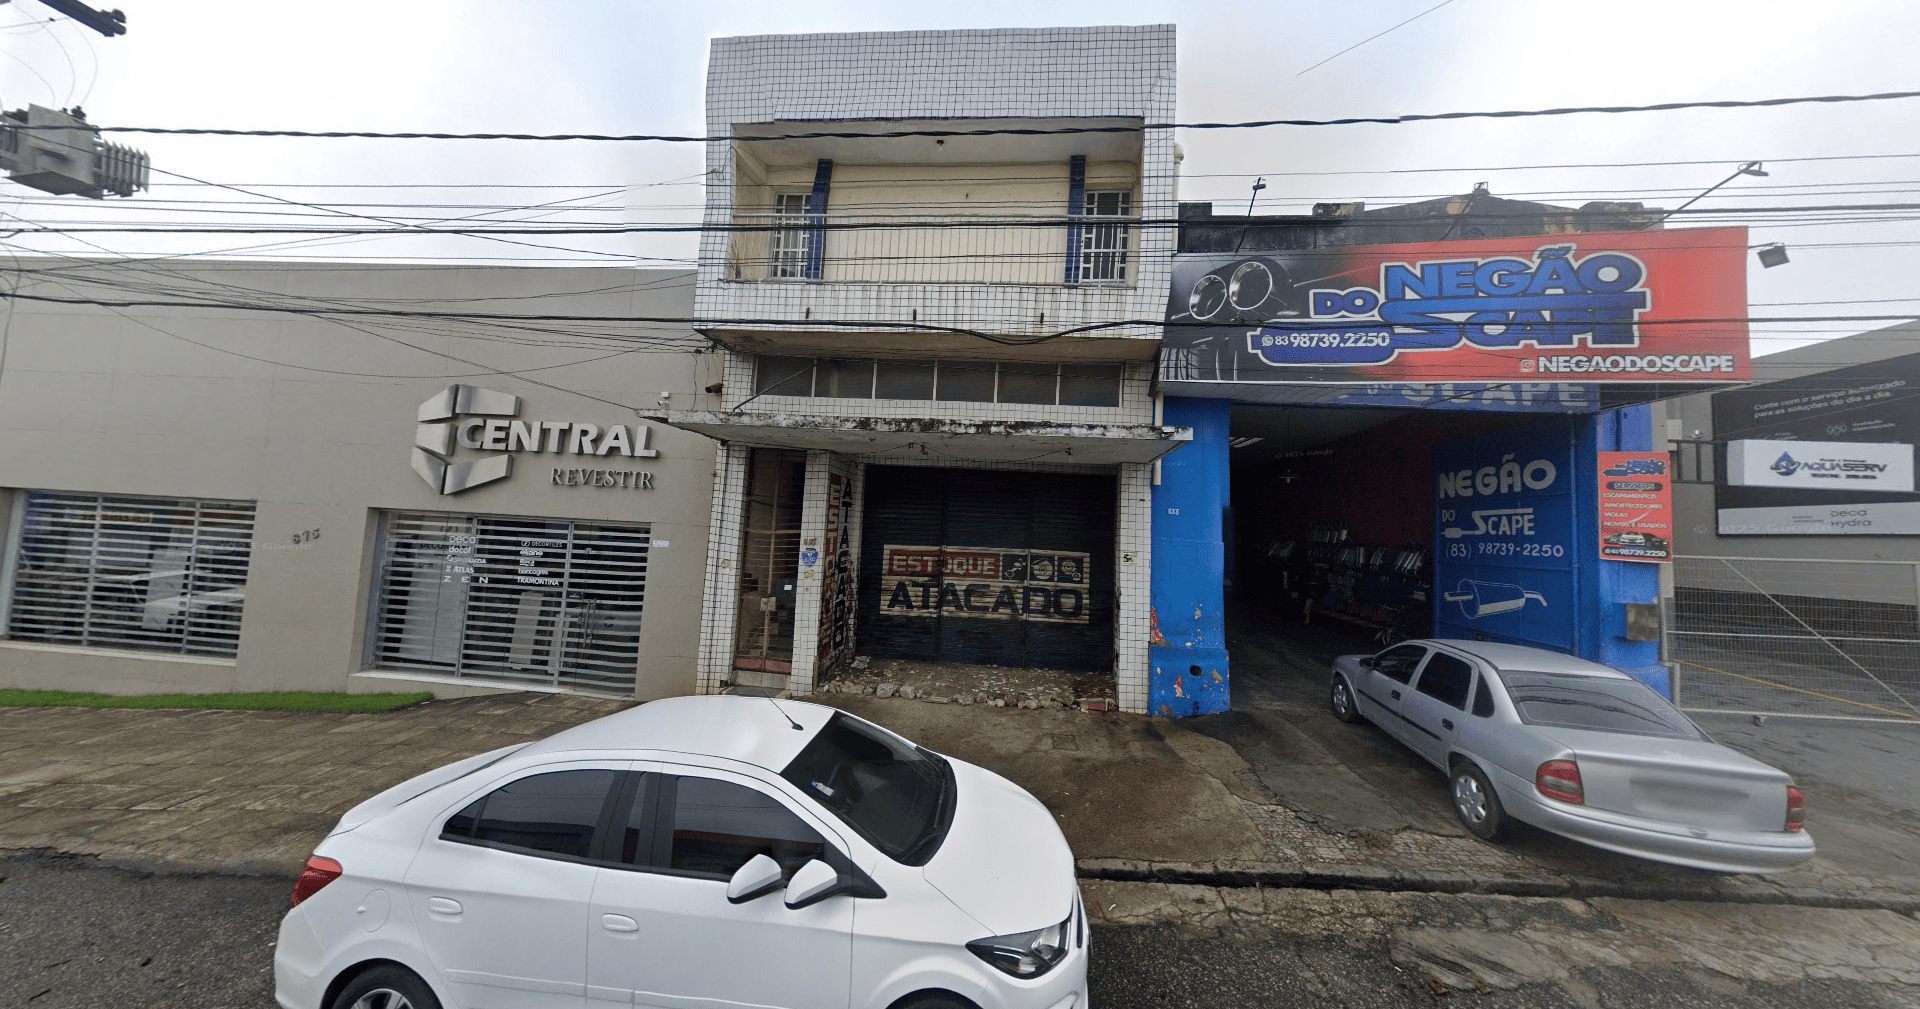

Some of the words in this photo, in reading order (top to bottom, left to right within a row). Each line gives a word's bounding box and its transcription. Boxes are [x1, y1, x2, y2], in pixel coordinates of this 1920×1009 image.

[1384, 246, 1643, 300] NEGÃO
[1314, 290, 1380, 318] DO
[1378, 292, 1647, 349] SCAPE
[1274, 335, 1289, 346] 83
[1290, 332, 1391, 348] 98739.2250
[1539, 354, 1734, 373] NEGAODOSCAPE
[1811, 389, 1846, 401] serviço
[457, 418, 659, 458] CENTRAL
[1439, 452, 1557, 499] NEGÃO
[1801, 461, 1887, 473] AQUASERV
[551, 467, 654, 490] REVESTIR
[1442, 509, 1456, 522] DO
[1471, 508, 1535, 535] SCAPE
[448, 546, 471, 554] docol
[1445, 542, 1472, 560] (83)
[1478, 542, 1564, 557] 98739-2250
[452, 565, 474, 574] ATLAS
[893, 555, 996, 576] ESTOQUE
[517, 576, 560, 586] TRAMONTINA
[887, 581, 1084, 618] ATACADO
